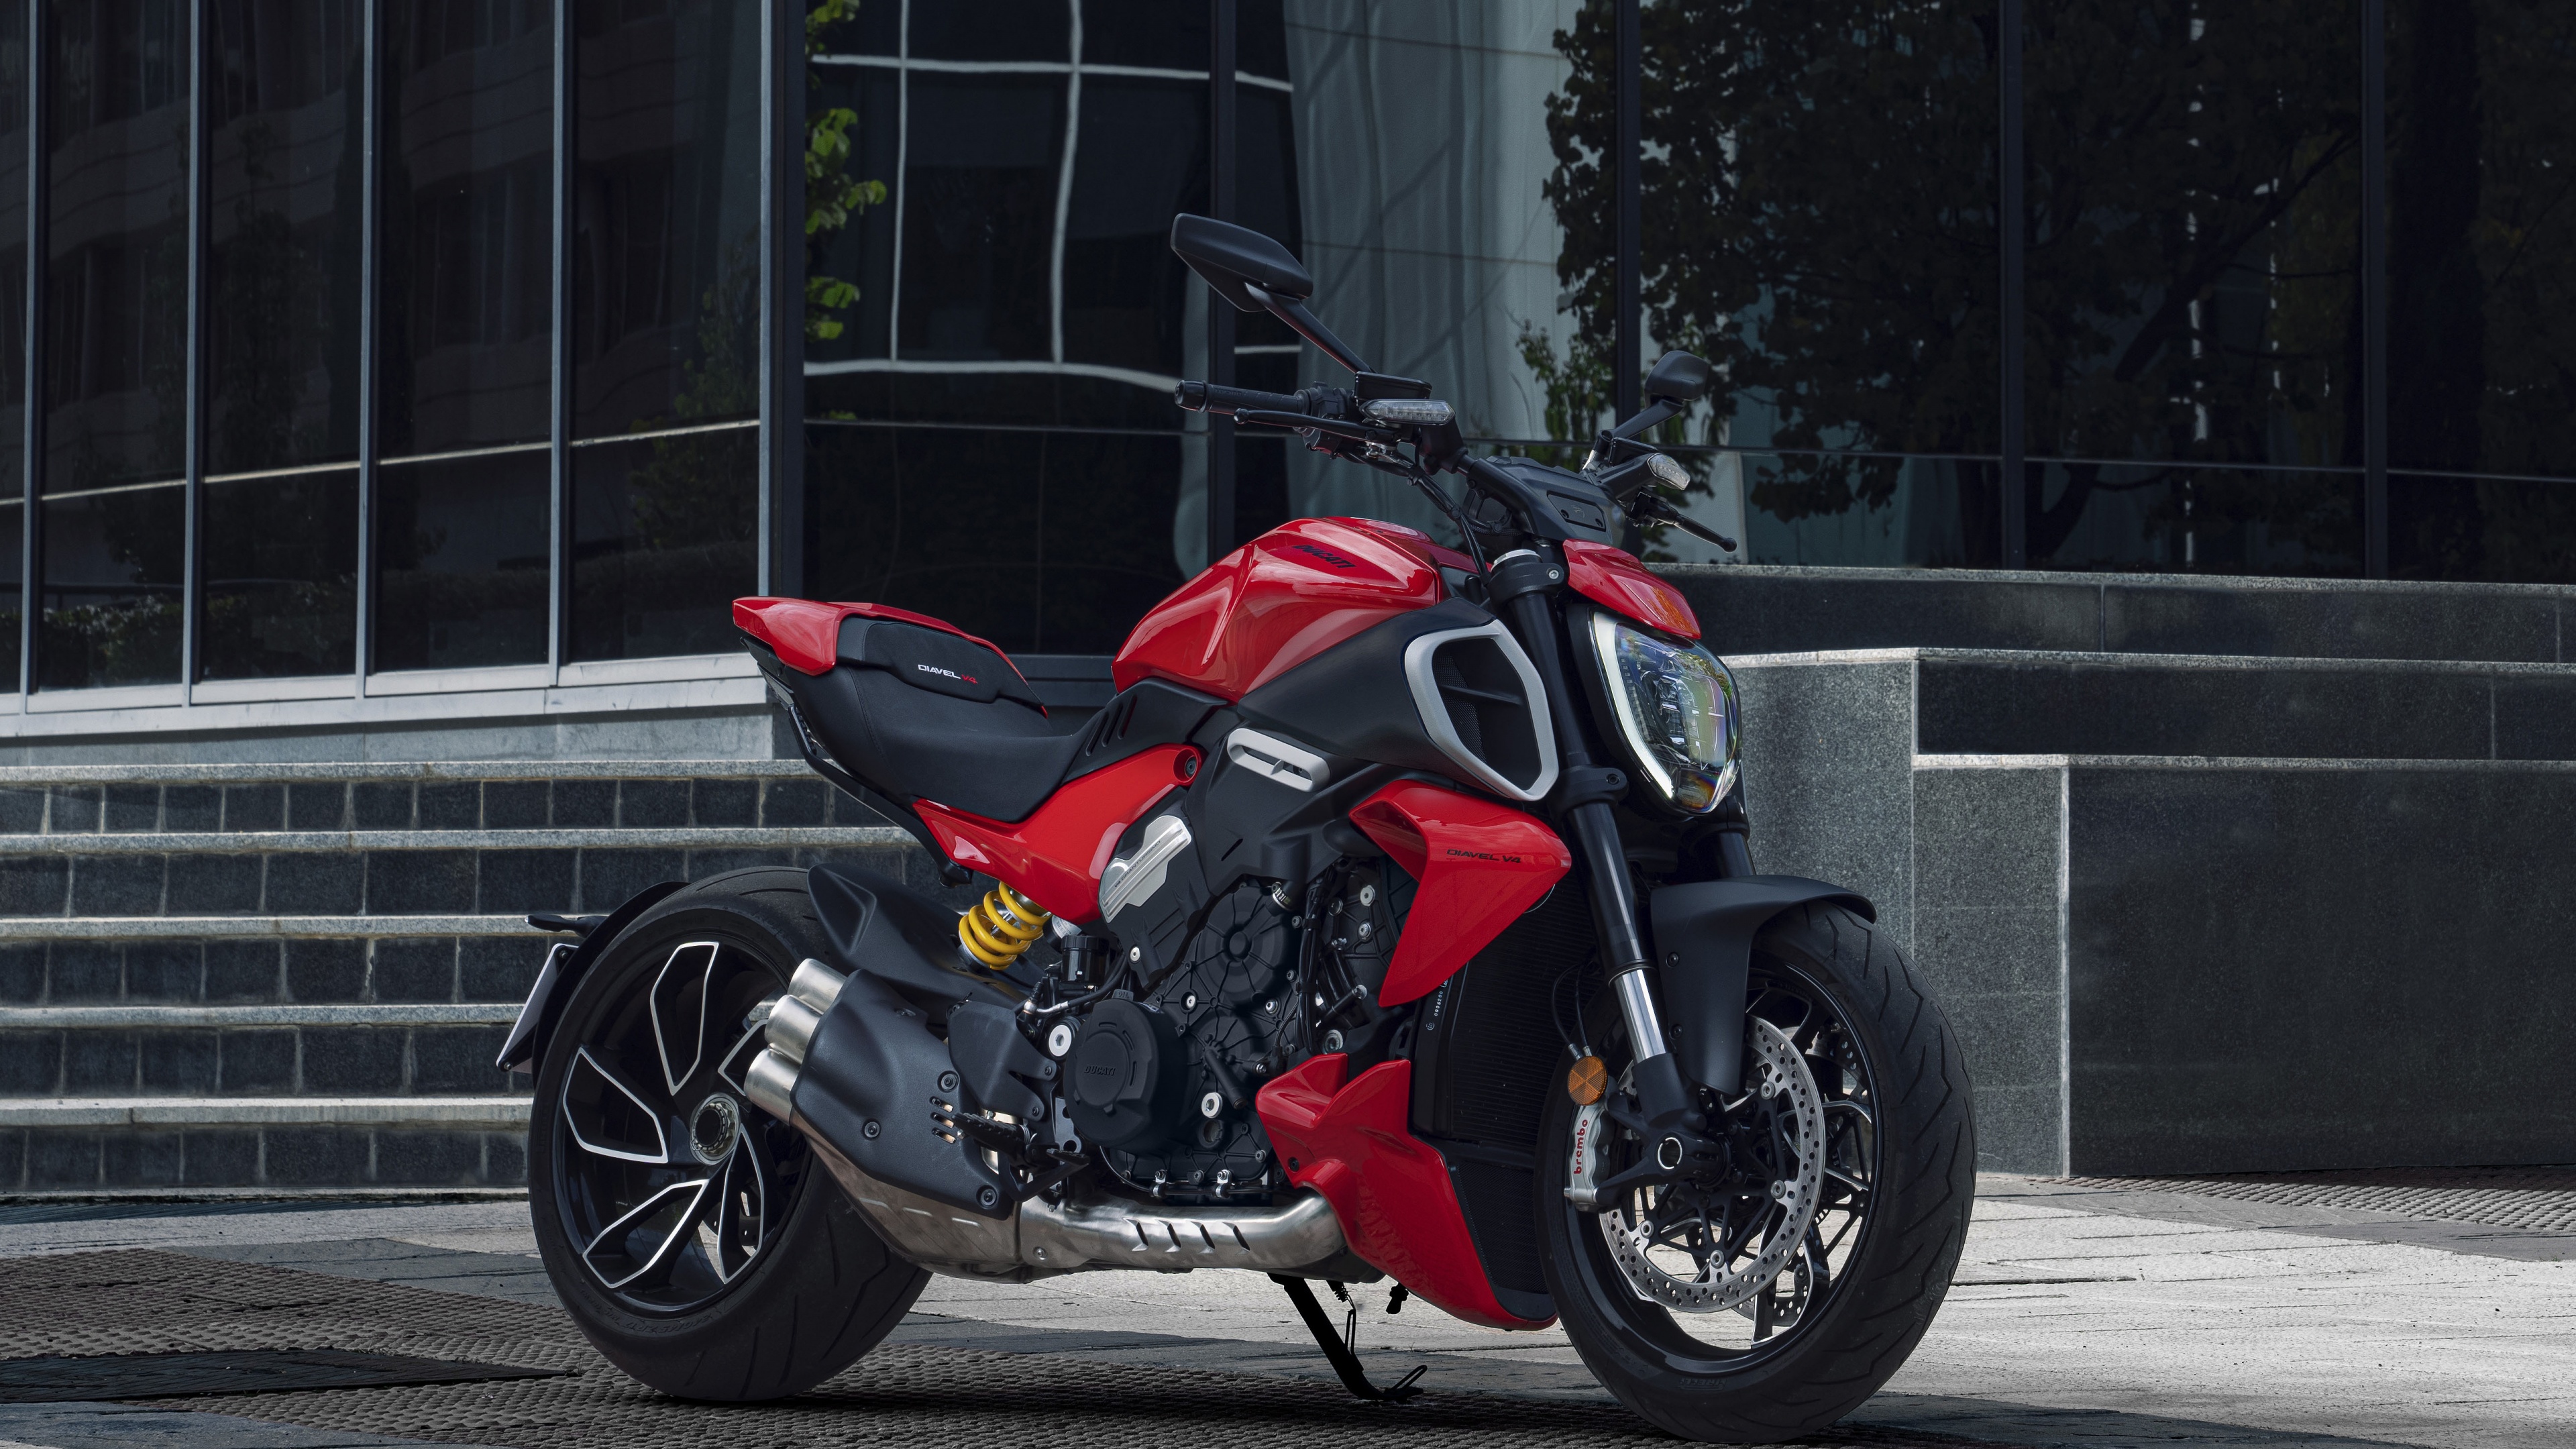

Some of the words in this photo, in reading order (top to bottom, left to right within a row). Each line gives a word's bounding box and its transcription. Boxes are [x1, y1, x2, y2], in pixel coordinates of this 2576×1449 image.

[1292, 545, 1356, 568] DUCATI
[918, 664, 961, 680] DIAVEL
[961, 674, 978, 684] V4
[1114, 879, 1121, 888] V4
[1121, 841, 1161, 880] GRANTURISMO
[1446, 849, 1500, 861] DIAVEL
[1502, 855, 1521, 863] V4
[1118, 991, 1130, 999] OIL
[1084, 1065, 1116, 1076] DUCATI
[1574, 1119, 1588, 1174] brembo
